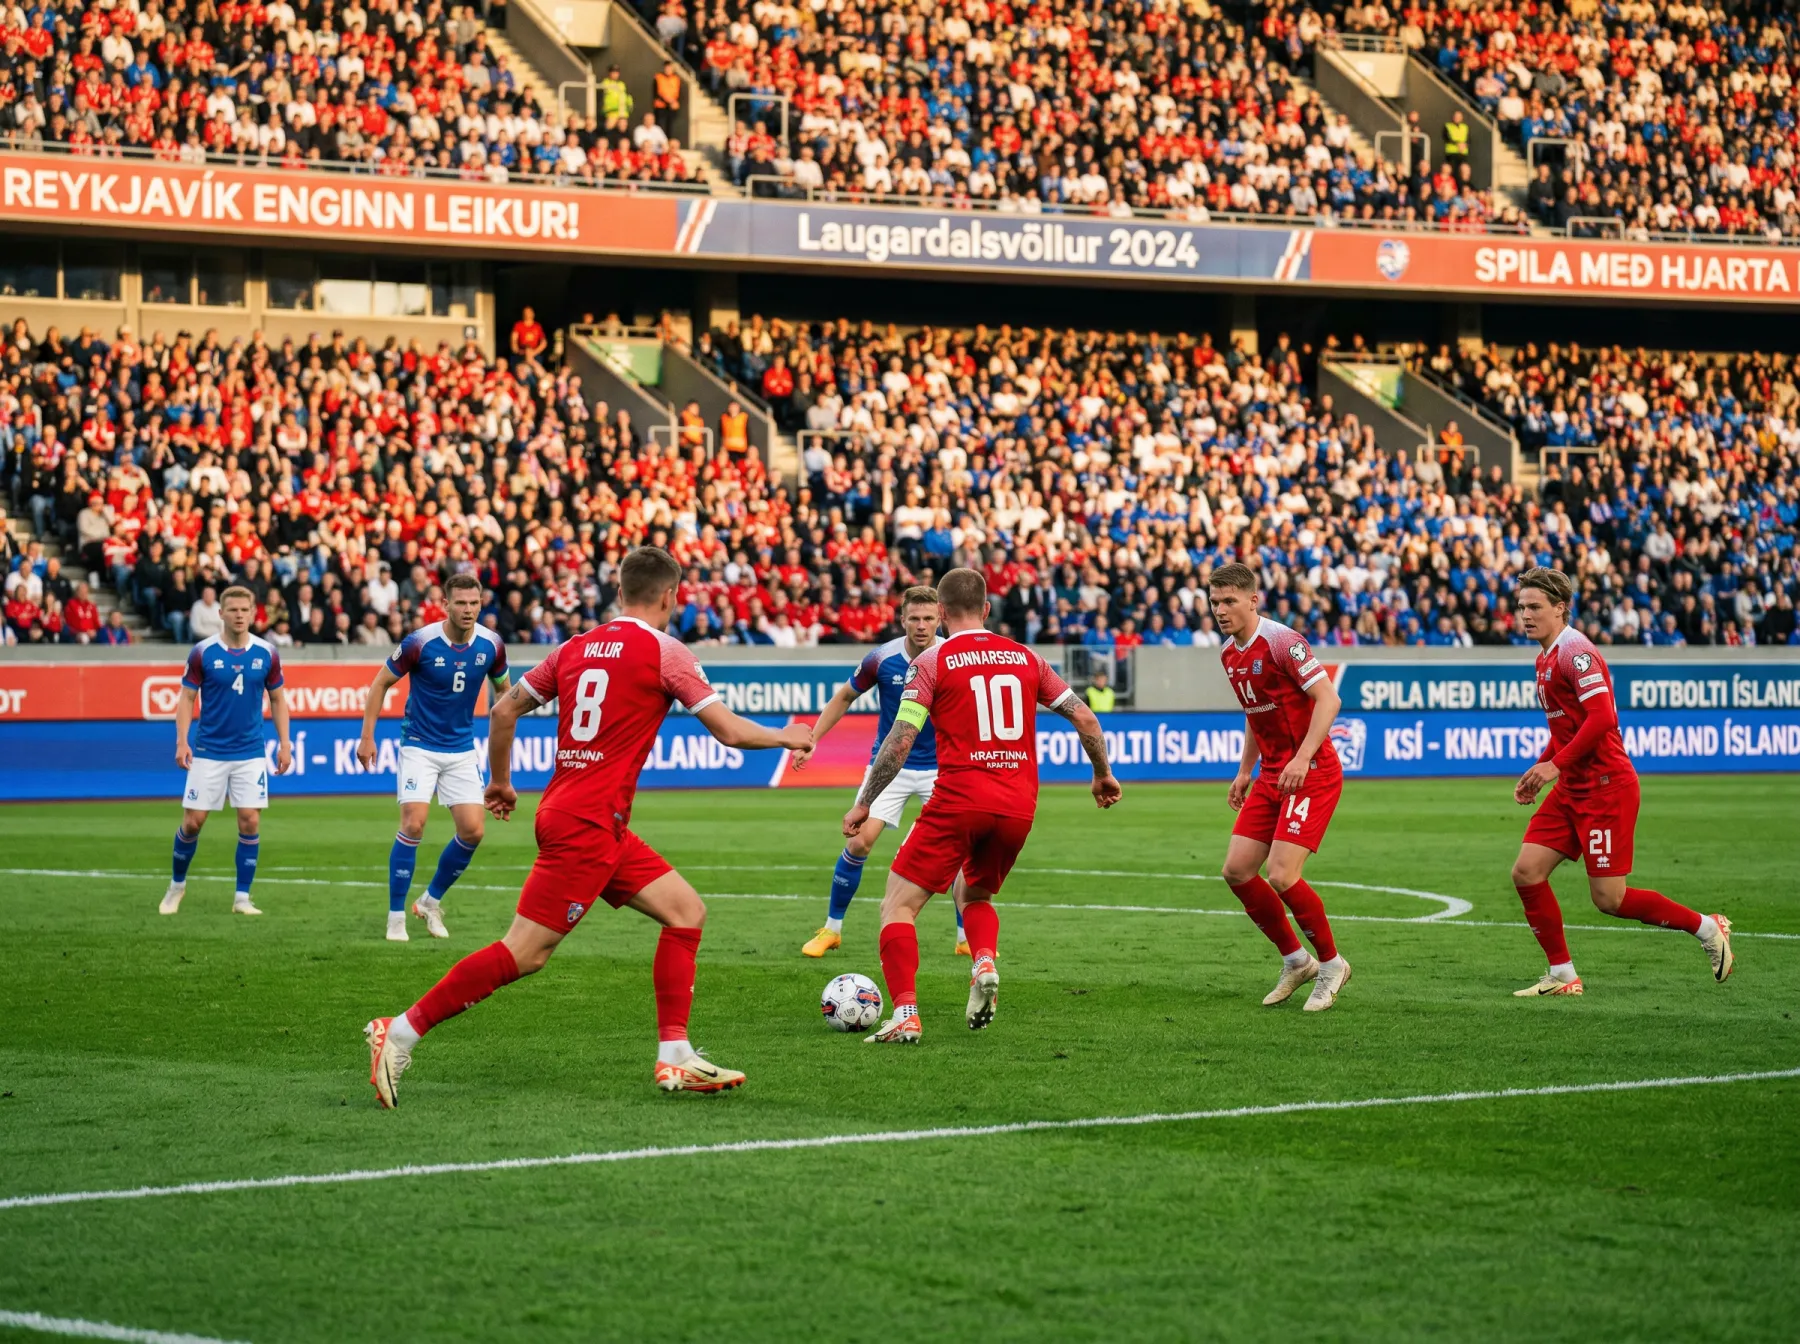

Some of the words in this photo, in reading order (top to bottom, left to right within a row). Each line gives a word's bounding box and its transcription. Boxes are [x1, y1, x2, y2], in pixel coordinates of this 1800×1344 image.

[5, 167, 243, 221] REYKJAVÍK
[253, 184, 414, 230] ENGINN
[425, 193, 580, 239] LEIKUR!
[798, 213, 1102, 264] Laugardalsvöllur
[1108, 229, 1200, 268] 2024
[1475, 247, 1574, 284] SPILA
[1661, 254, 1791, 293] HJARTA
[583, 642, 624, 658] VALUR
[945, 650, 1029, 670] GUNNARSSON
[232, 673, 244, 695] 4
[452, 671, 467, 693] 6
[1237, 679, 1257, 704] 14
[1360, 680, 1425, 710] SPILA
[1480, 680, 1543, 709] HJAR
[1630, 680, 1727, 708] FOTBOLTI
[570, 669, 610, 742] 8
[969, 674, 1024, 742] 10
[1384, 720, 1424, 761] KSÍ
[1445, 726, 1551, 760] KNATTSP
[1618, 725, 1719, 757] AMBAND
[257, 771, 265, 788] 4
[1285, 794, 1311, 822] 14
[1589, 828, 1612, 855] 21
